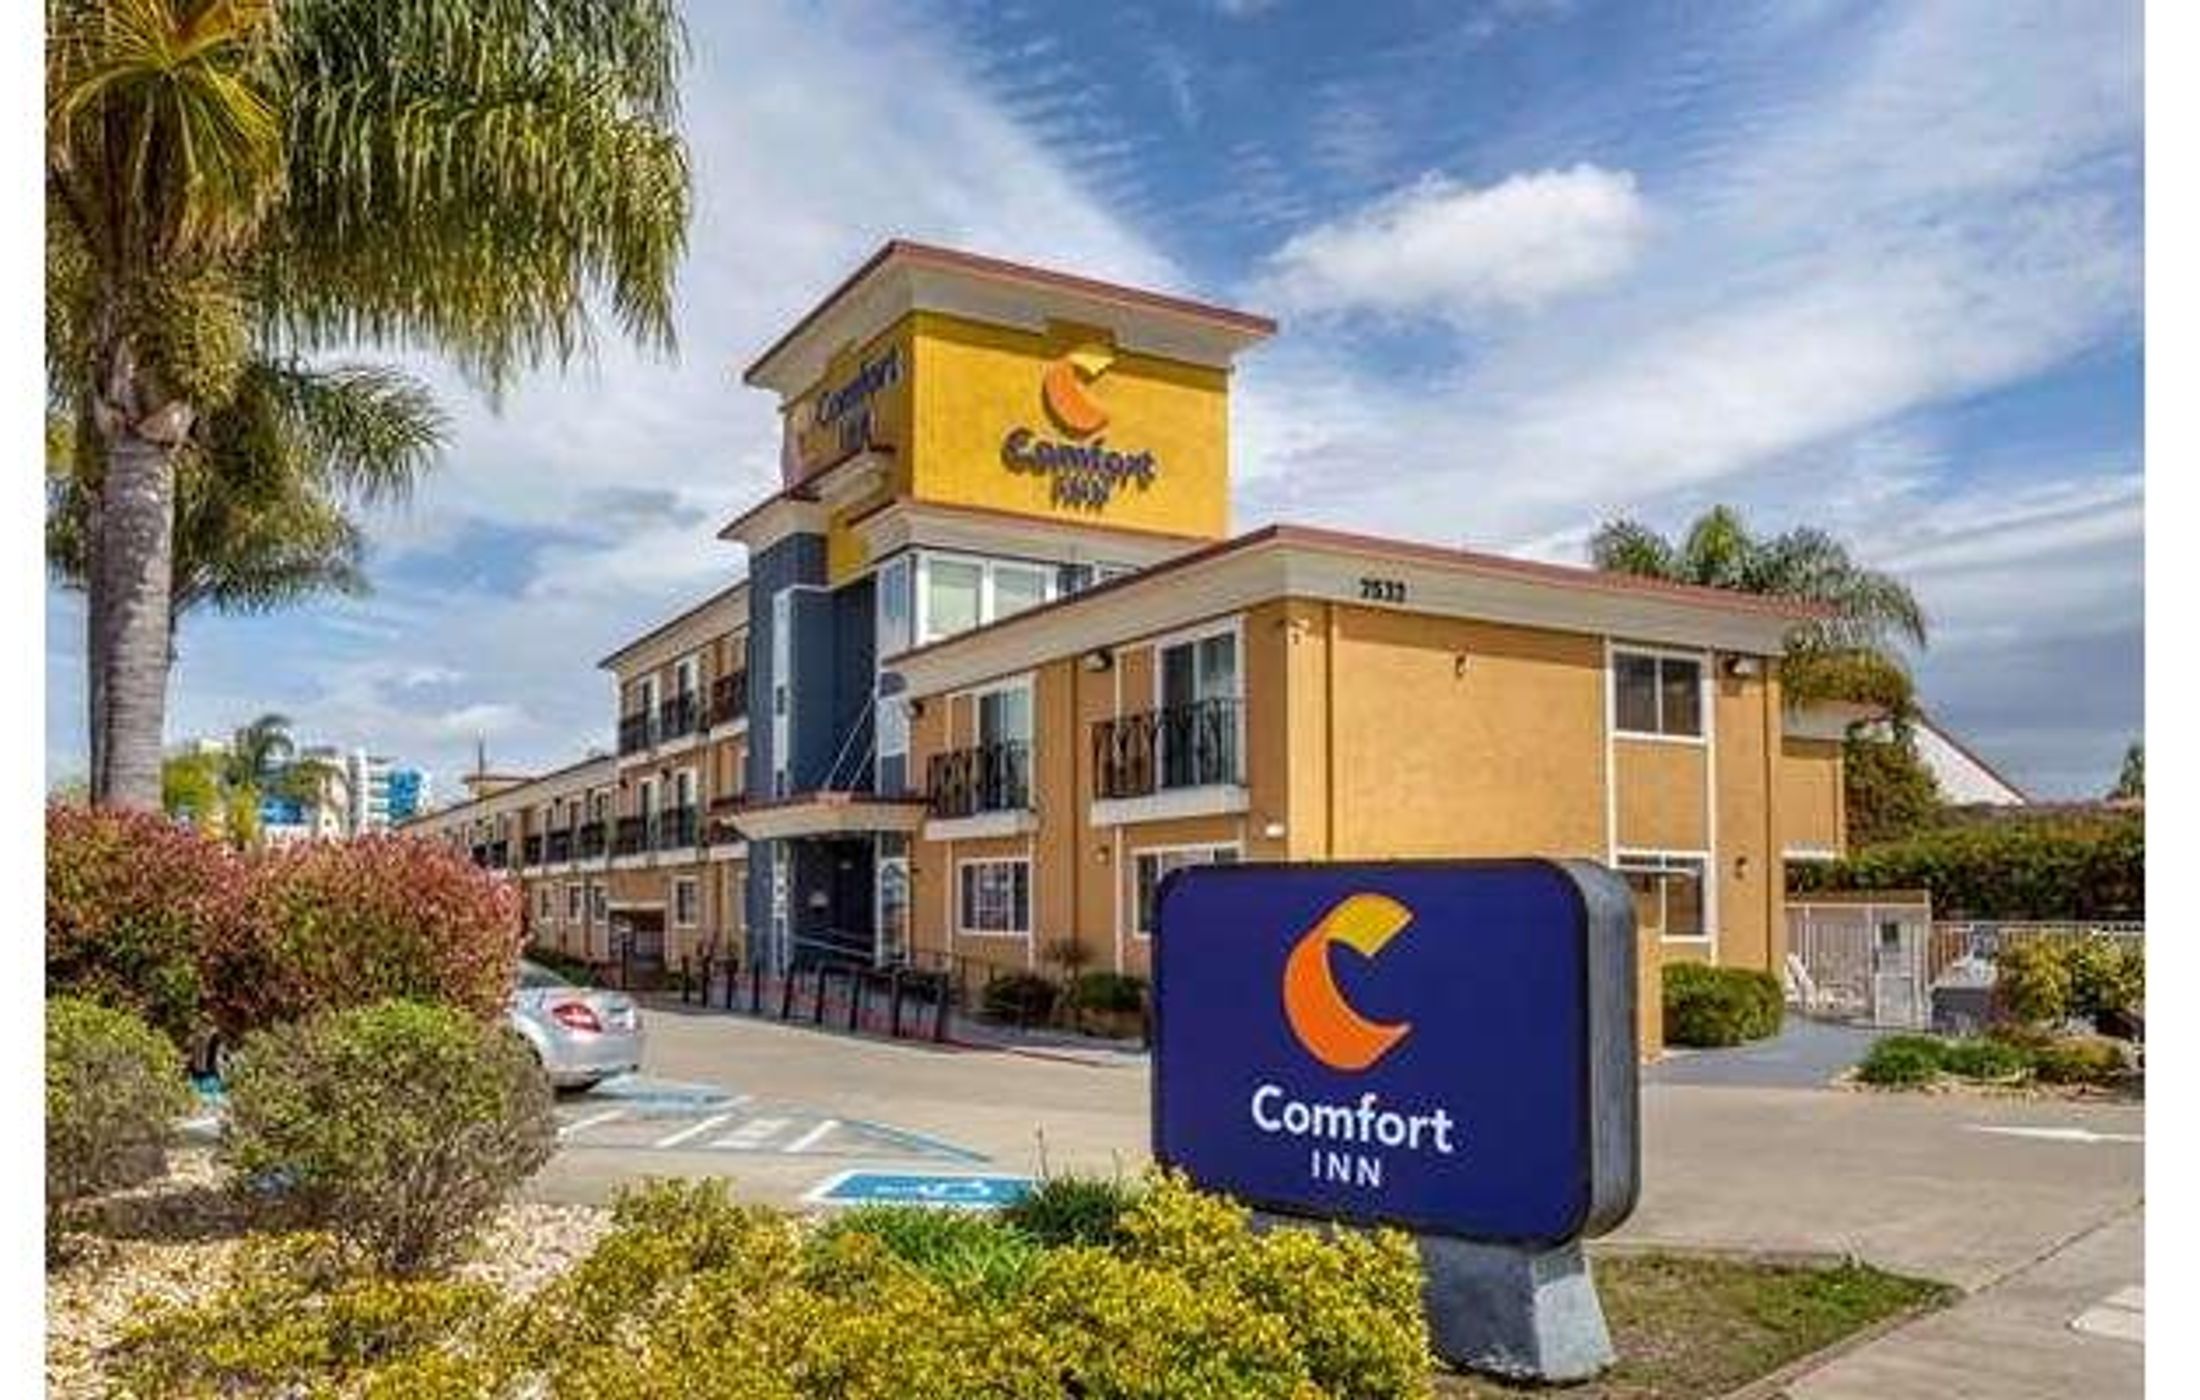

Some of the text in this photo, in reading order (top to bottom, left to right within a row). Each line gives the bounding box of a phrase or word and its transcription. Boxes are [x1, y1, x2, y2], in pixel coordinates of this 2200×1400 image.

[1002, 428, 1155, 484] Comfort
[1252, 1085, 1454, 1153] Comfort
[1311, 1150, 1381, 1187] INN
